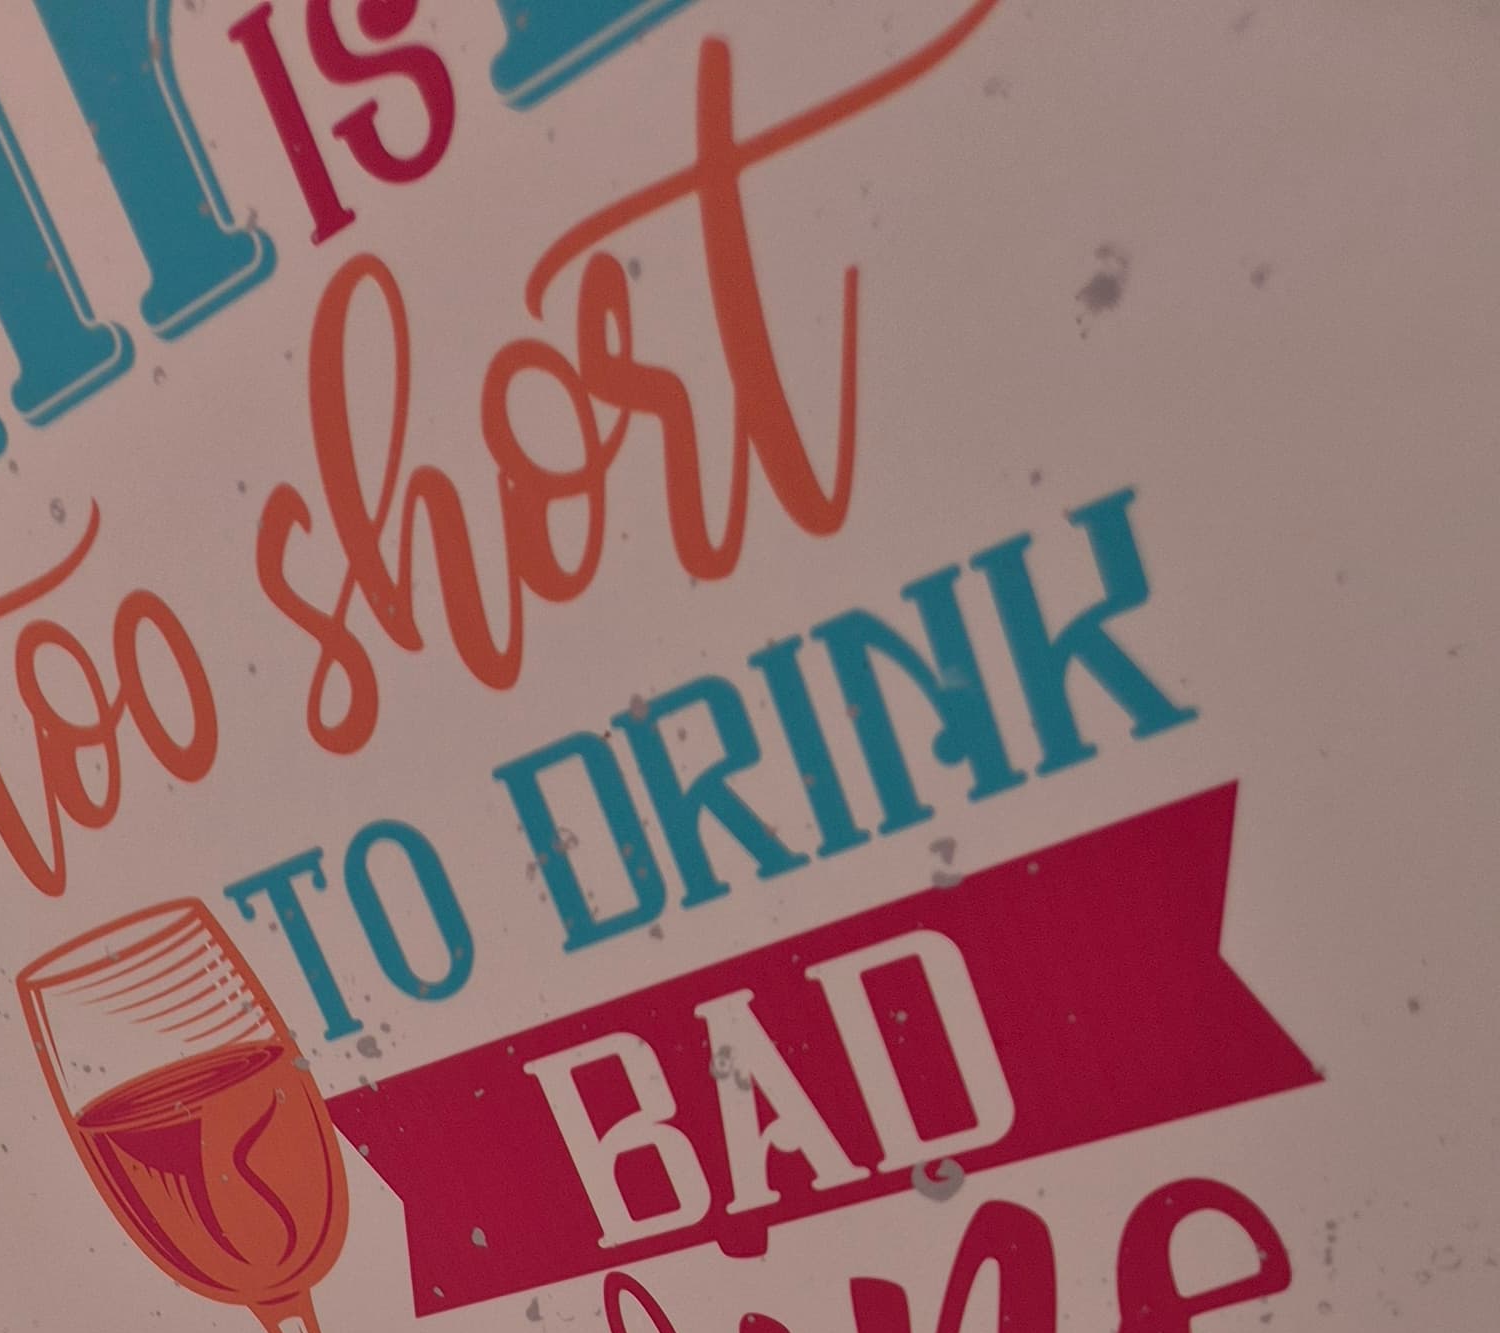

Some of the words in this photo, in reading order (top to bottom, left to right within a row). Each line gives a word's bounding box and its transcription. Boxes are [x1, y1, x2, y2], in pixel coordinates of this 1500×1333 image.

[229, 0, 456, 244] IS
[256, 0, 1000, 756] short
[223, 818, 477, 1043] TO
[493, 488, 1198, 953] DRINK
[523, 928, 1016, 1250] BAD
